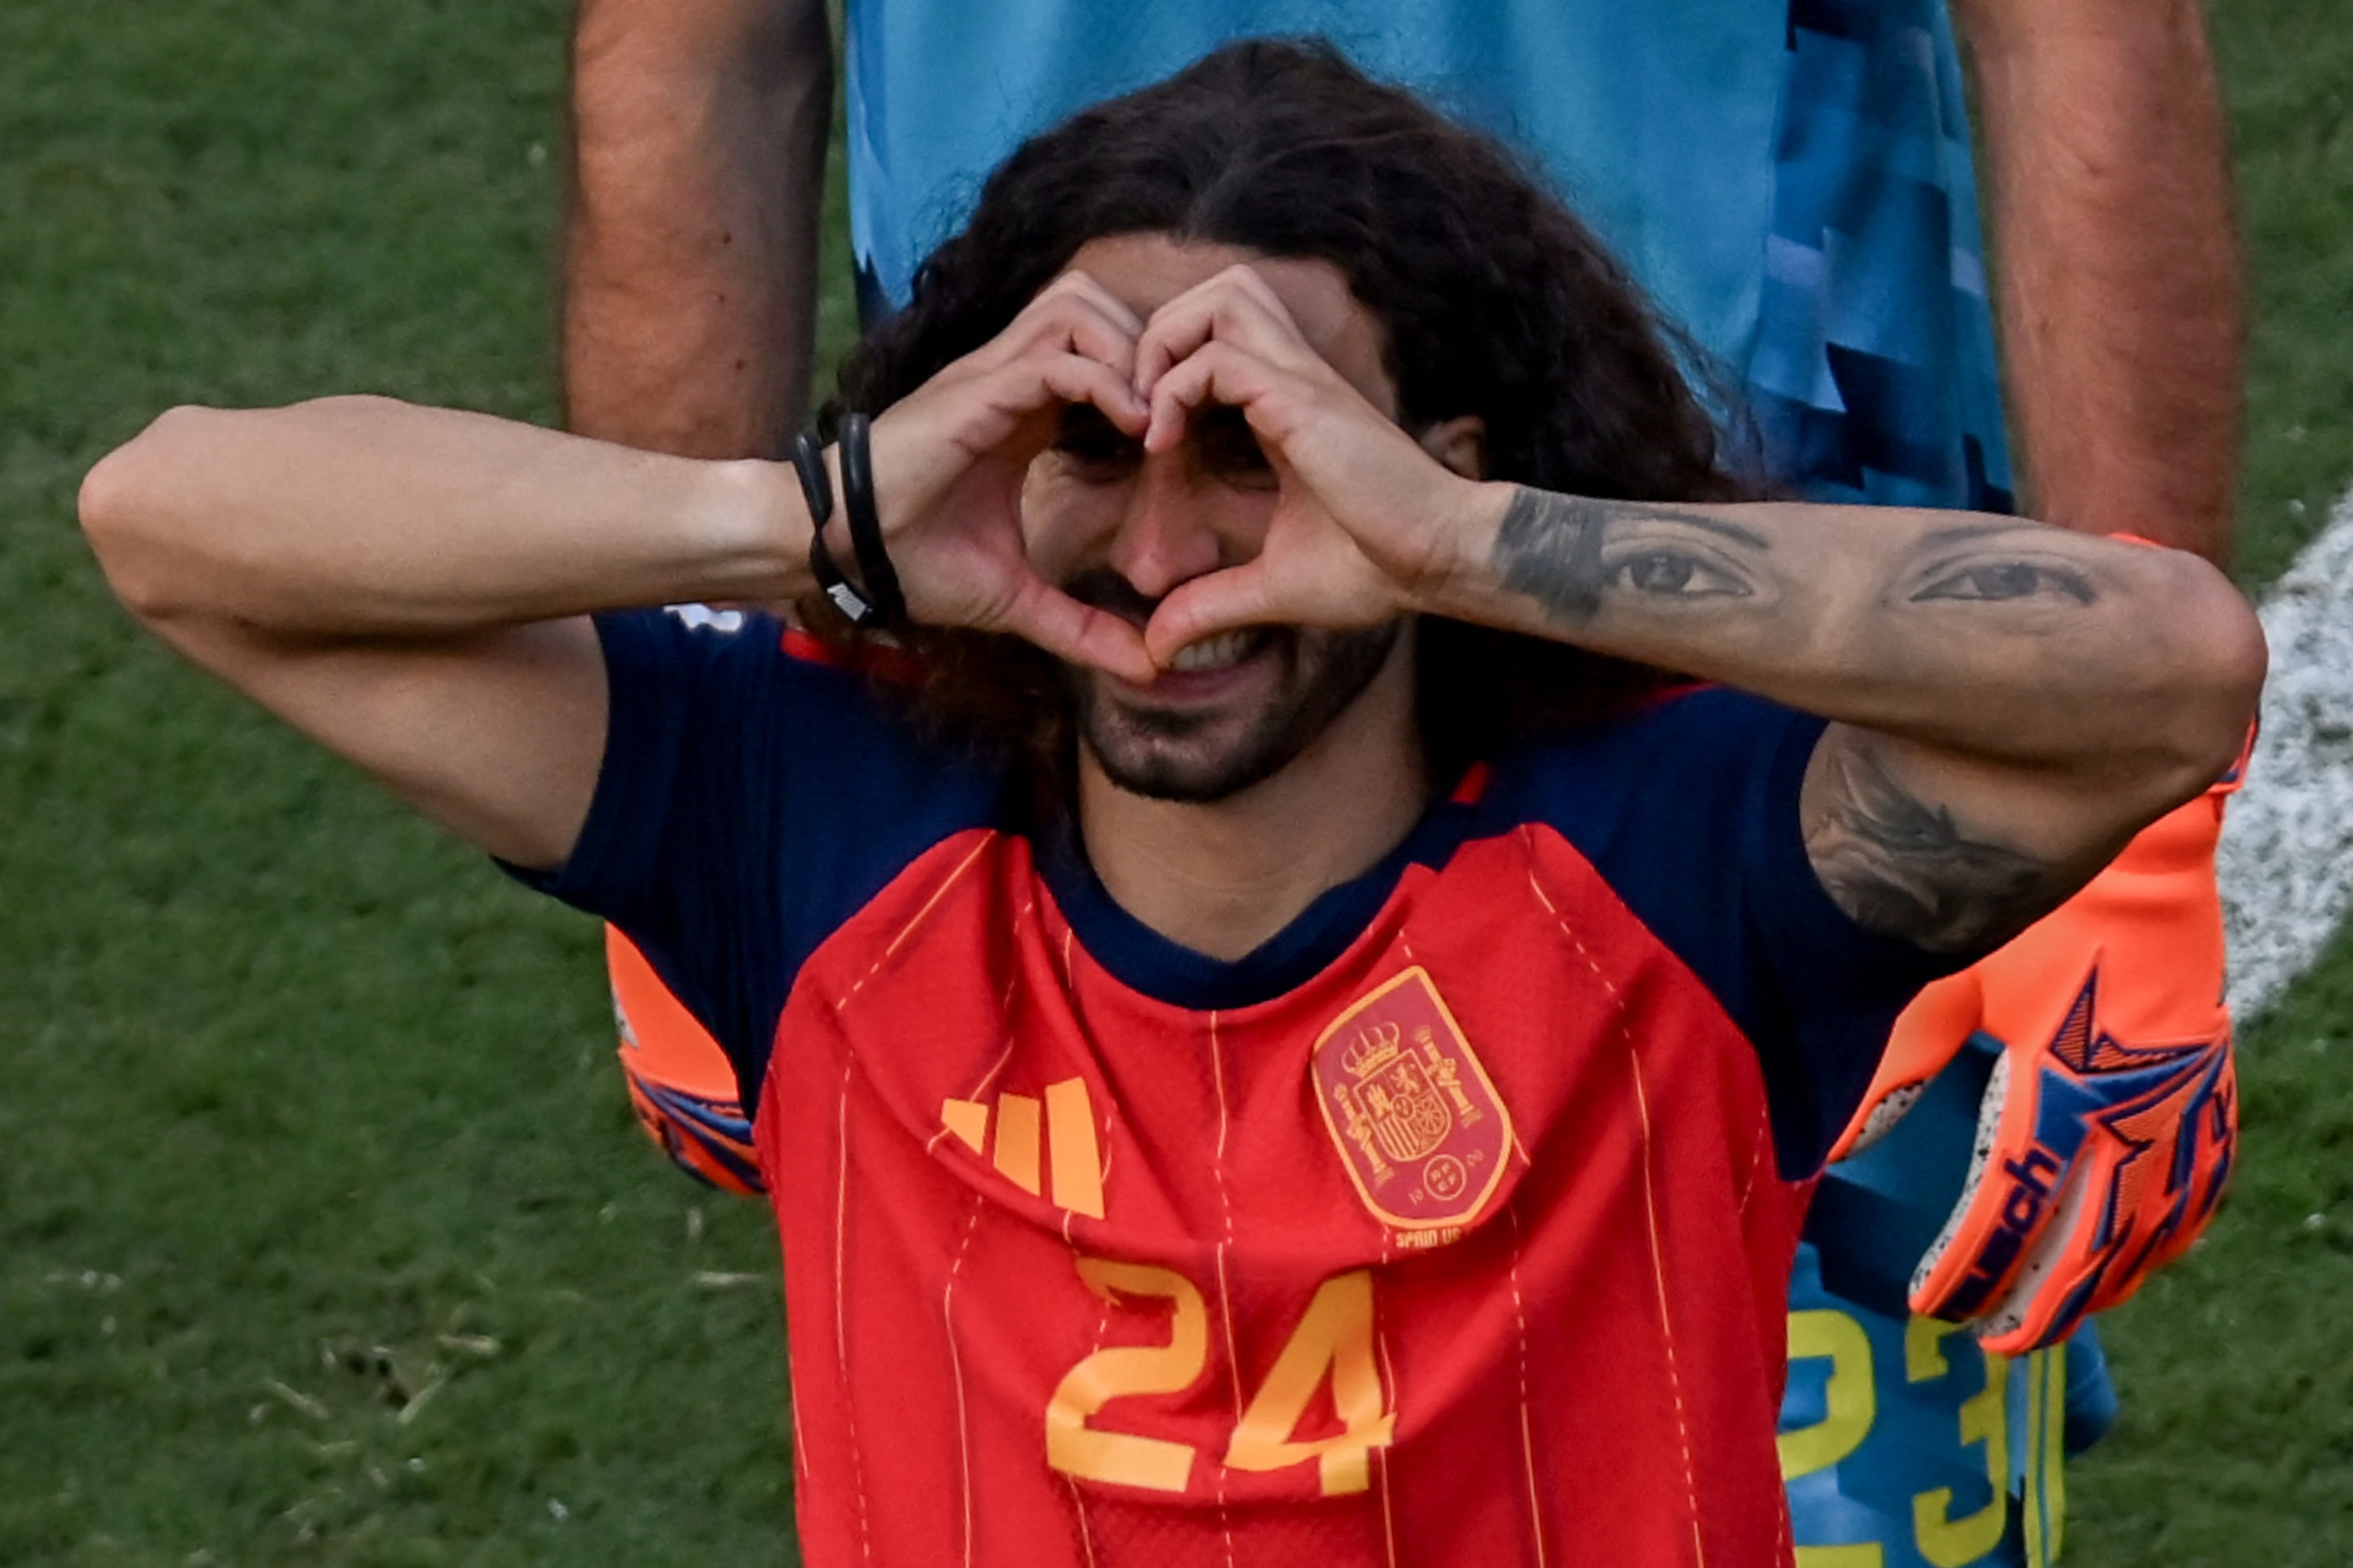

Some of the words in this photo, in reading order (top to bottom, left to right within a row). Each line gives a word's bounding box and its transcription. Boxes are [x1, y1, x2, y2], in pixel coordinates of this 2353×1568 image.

[1395, 1229, 1438, 1249] SPAIN
[1045, 1256, 1397, 1497] 24
[1776, 1308, 2009, 1568] 23
